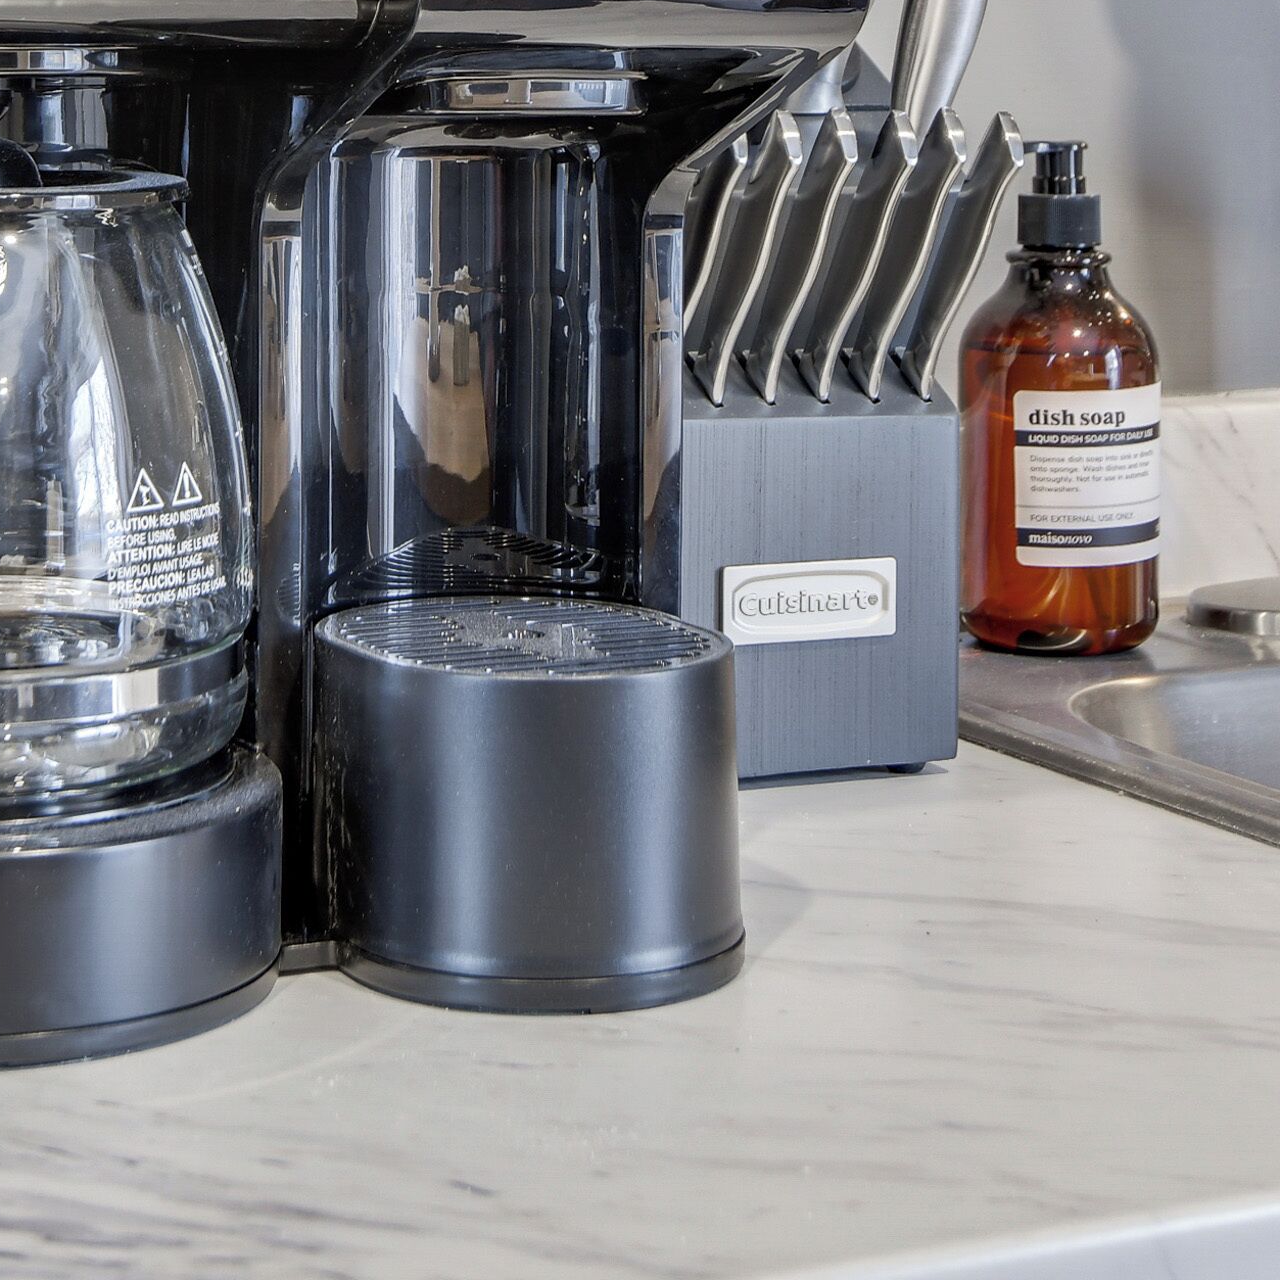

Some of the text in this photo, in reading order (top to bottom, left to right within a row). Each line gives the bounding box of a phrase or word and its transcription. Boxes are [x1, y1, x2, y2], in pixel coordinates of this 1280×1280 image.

[1029, 409, 1126, 427] dish soap
[1028, 434, 1059, 444] LIQUID
[1060, 435, 1084, 444] DISH
[1084, 434, 1109, 443] SOAP
[1110, 432, 1126, 441] FOR
[1030, 454, 1065, 463] Dispense
[106, 515, 159, 534] CAUTION:
[160, 513, 179, 526] READ
[1030, 513, 1048, 522] FOR
[1051, 514, 1096, 523] EXTERNAL
[107, 532, 146, 549] BEFORE
[1028, 531, 1093, 544] maisonovo
[107, 545, 176, 565] ATTENTION:
[177, 540, 193, 554] LIRE
[194, 538, 202, 549] LE
[108, 564, 150, 580] D'EMPLOI
[152, 559, 179, 573] AVANT
[108, 573, 185, 595] PRECAUCION:
[177, 583, 201, 599] ANTES
[739, 589, 870, 616] Cuisinart
